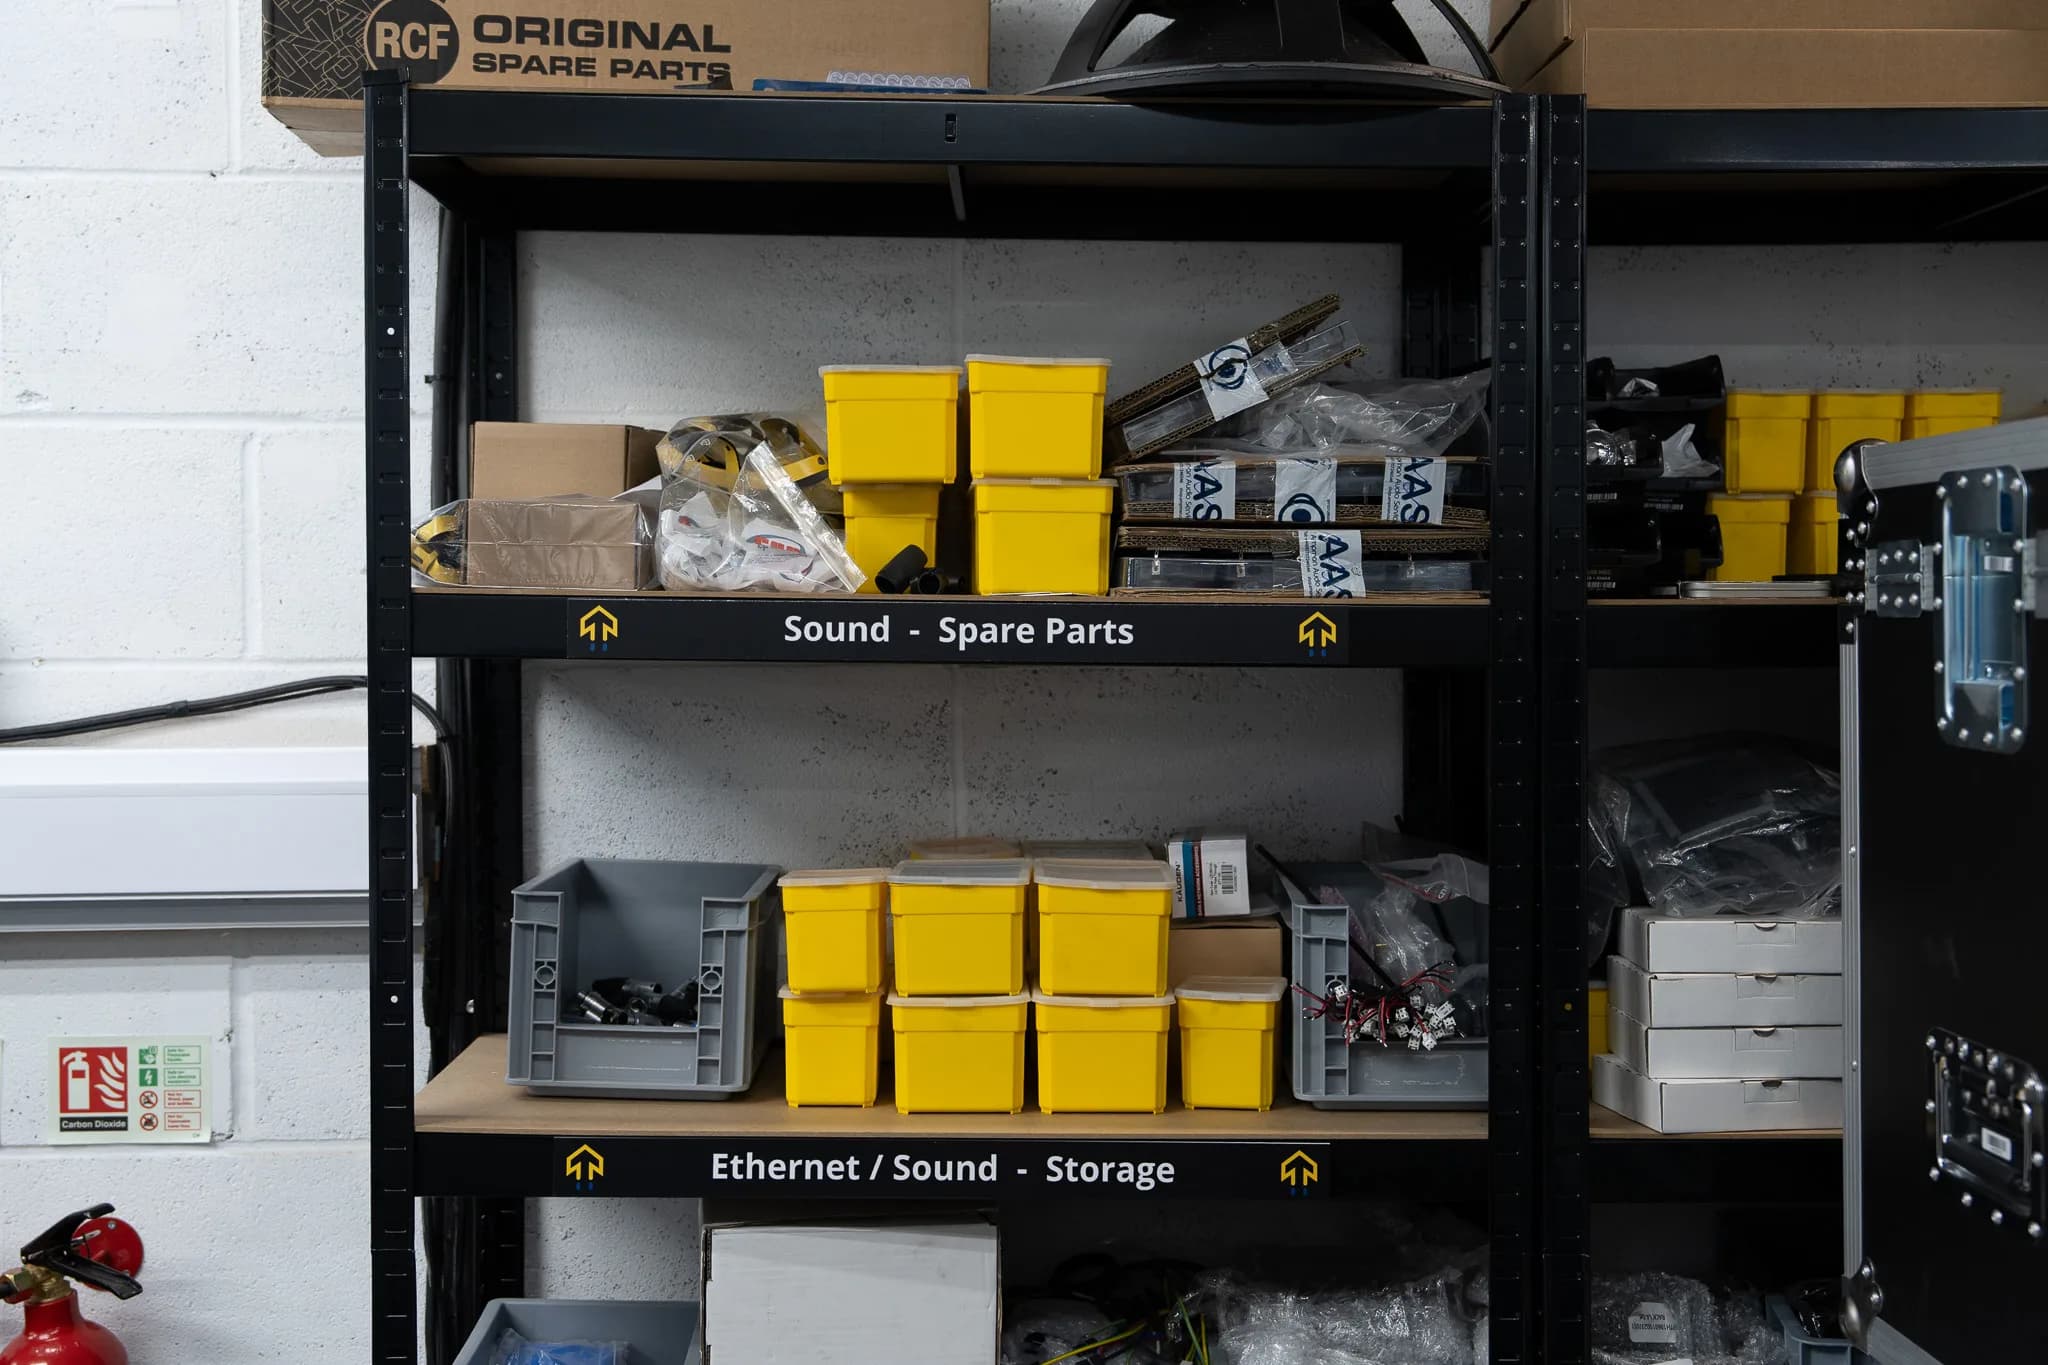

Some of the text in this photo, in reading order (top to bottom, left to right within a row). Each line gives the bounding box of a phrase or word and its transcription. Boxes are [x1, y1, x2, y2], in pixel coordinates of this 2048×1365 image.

[375, 21, 451, 60] RCF
[473, 14, 732, 53] ORIGINAL
[473, 53, 731, 82] SPARE PARTS
[784, 615, 890, 643] Sound
[939, 617, 1035, 651] Spare
[1046, 618, 1134, 645] Parts
[62, 1120, 126, 1129] Carbon Dioxide
[711, 1152, 861, 1181] Ethernet
[869, 1154, 884, 1180] /
[893, 1154, 997, 1182] Sound
[1045, 1155, 1175, 1191] Storage
